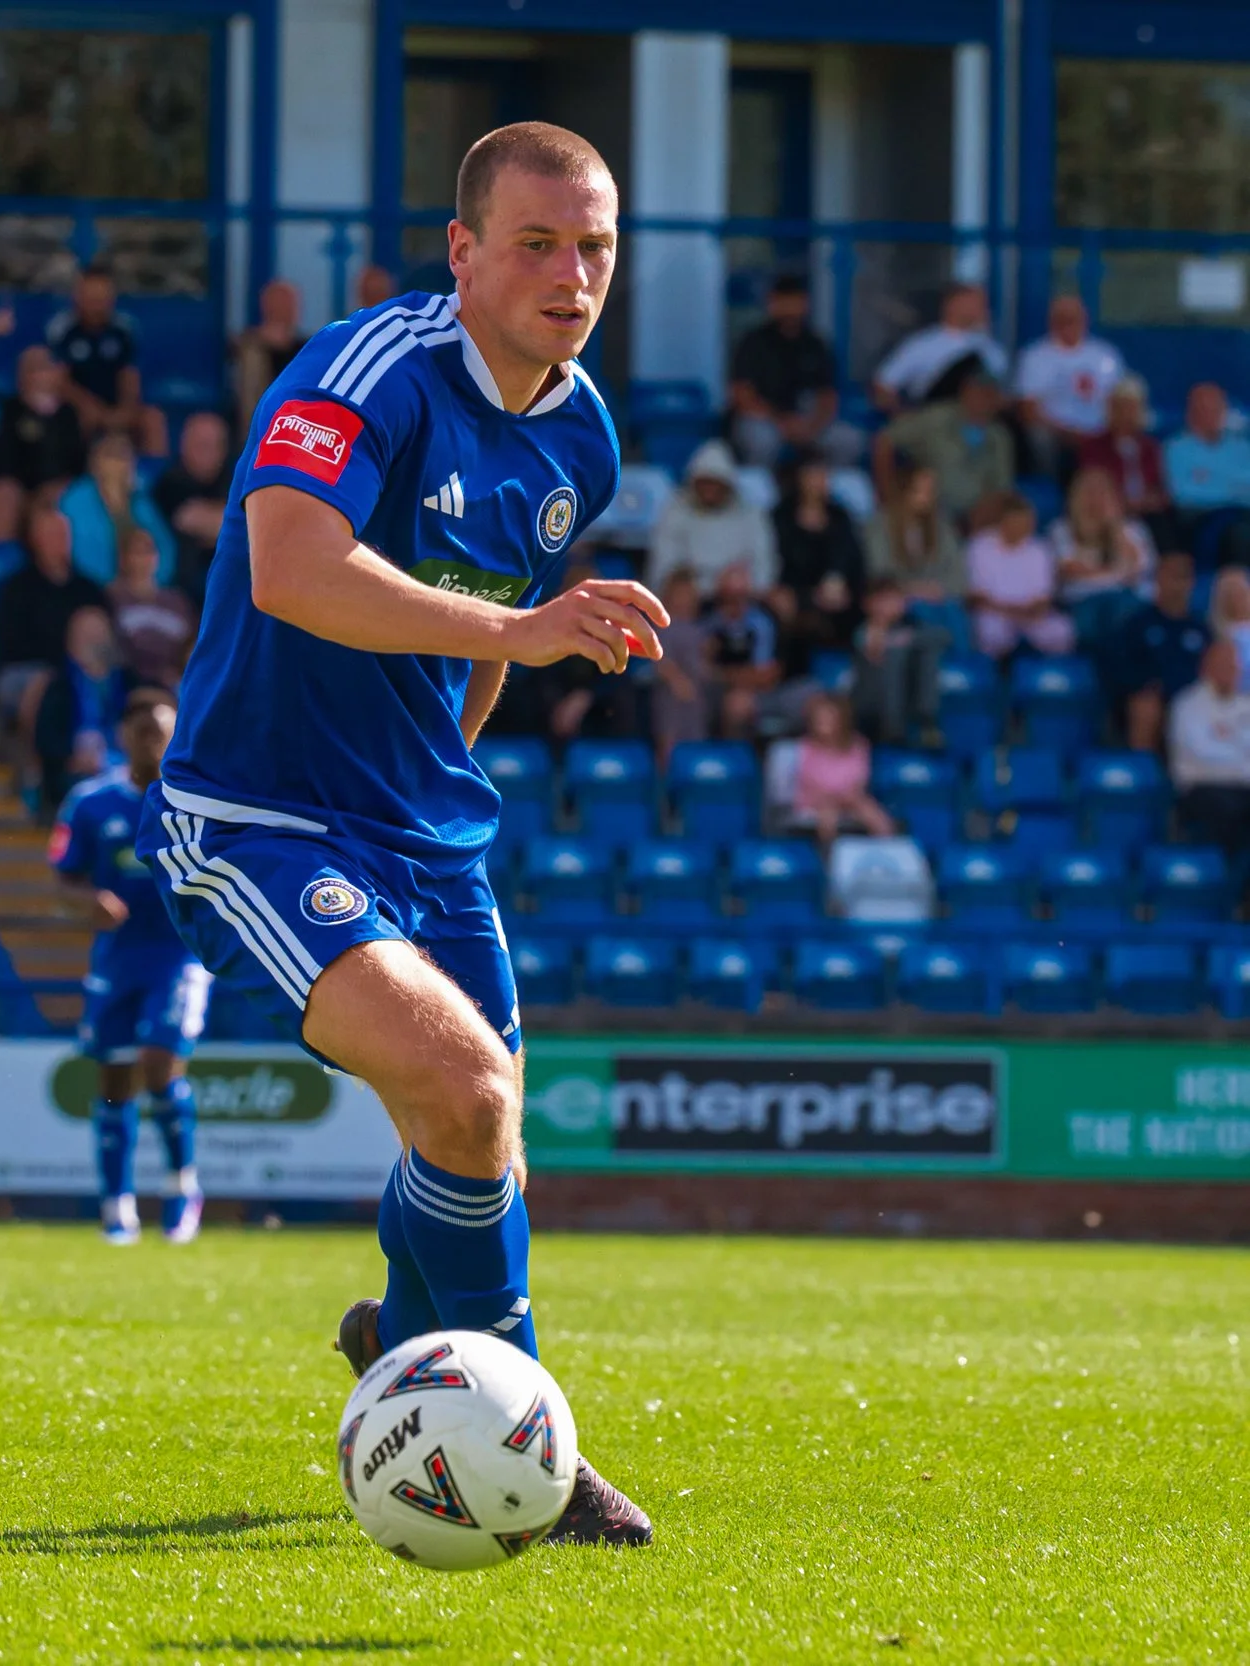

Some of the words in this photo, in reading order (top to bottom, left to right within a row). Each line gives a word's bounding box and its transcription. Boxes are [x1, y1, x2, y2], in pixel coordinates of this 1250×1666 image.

[281, 417, 337, 449] PITCHING
[301, 434, 317, 452] IN
[323, 880, 356, 894] ASHTON
[540, 1068, 993, 1148] enterprise
[363, 1405, 423, 1482] Mitre
